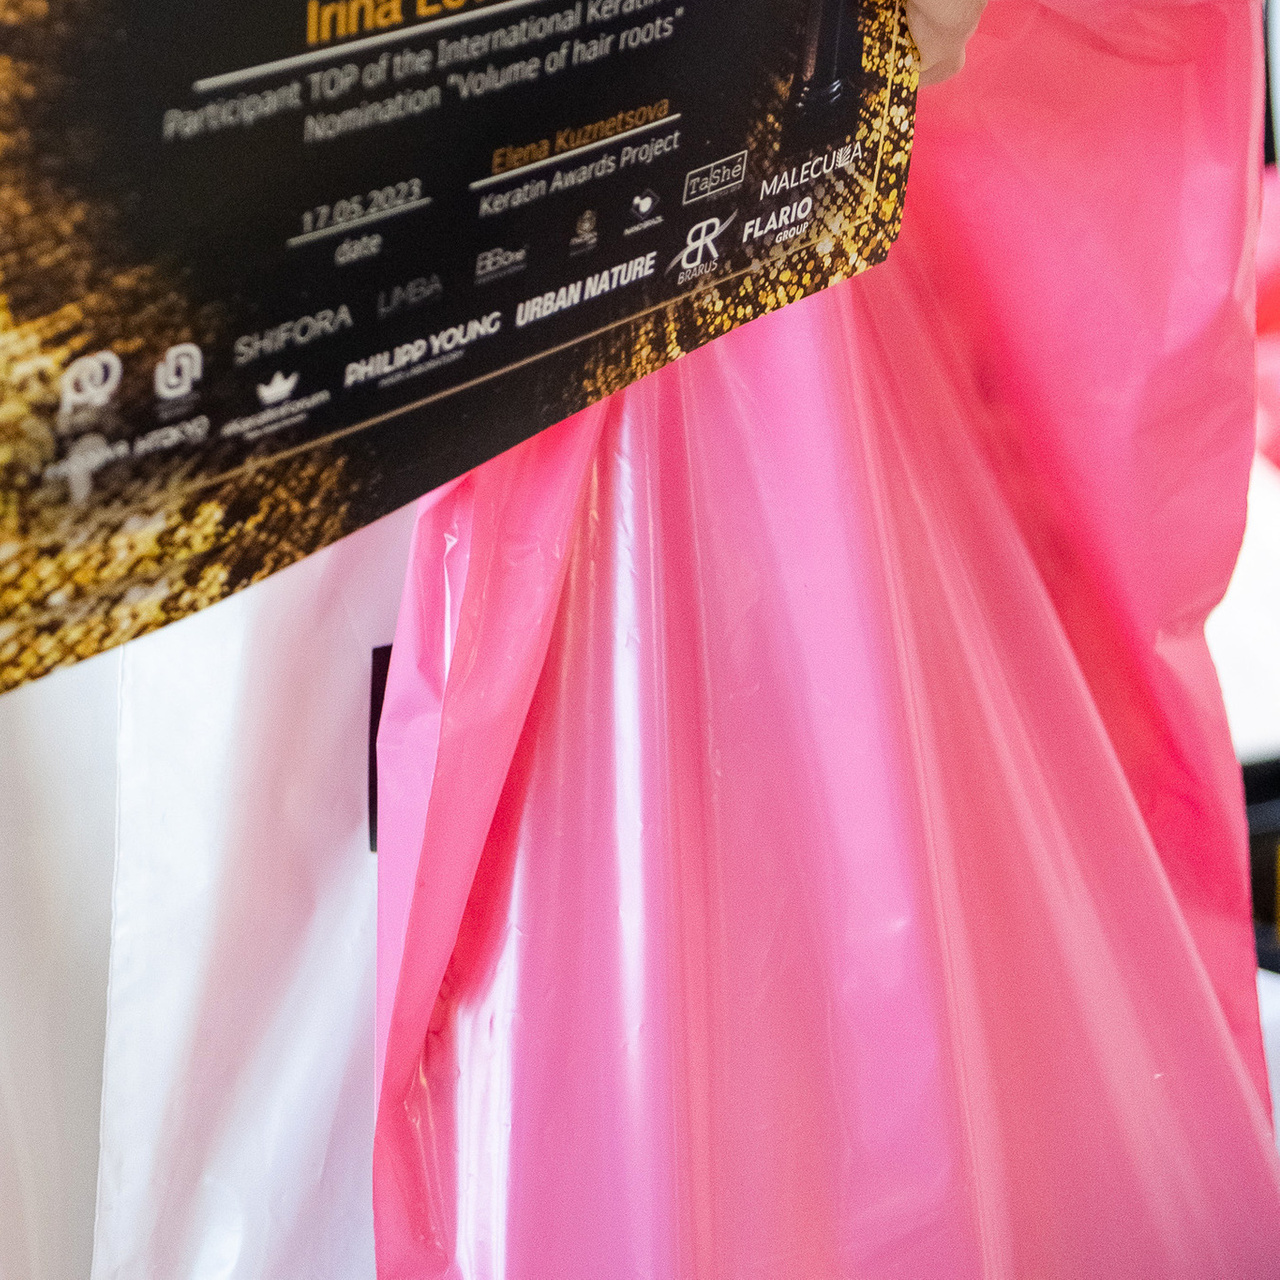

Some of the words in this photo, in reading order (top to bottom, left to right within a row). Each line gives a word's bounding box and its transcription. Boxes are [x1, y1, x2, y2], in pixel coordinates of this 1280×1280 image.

[163, 83, 302, 138] Participant
[306, 63, 360, 101] TOP
[361, 52, 391, 89] of
[393, 45, 432, 80] the
[438, 2, 582, 69] International
[304, 85, 441, 142] Nomination
[447, 57, 540, 98] "Volume
[545, 40, 569, 74] of
[571, 33, 615, 65] hair
[619, 6, 684, 50] roots"
[479, 177, 546, 217] Keratin
[549, 152, 615, 193] Awards
[621, 130, 681, 169] Project
[492, 139, 549, 175] Elena
[555, 98, 669, 152] Kuznetsova
[335, 234, 382, 266] date
[742, 196, 813, 243] FLARIO
[775, 222, 809, 244] GROUP
[515, 281, 579, 328] URBAN
[584, 251, 657, 299] NATURE
[677, 259, 718, 285] BRARUS
[233, 303, 354, 367] SHIFORA
[343, 337, 428, 389] PHILIPP
[429, 310, 504, 356] YOUNG
